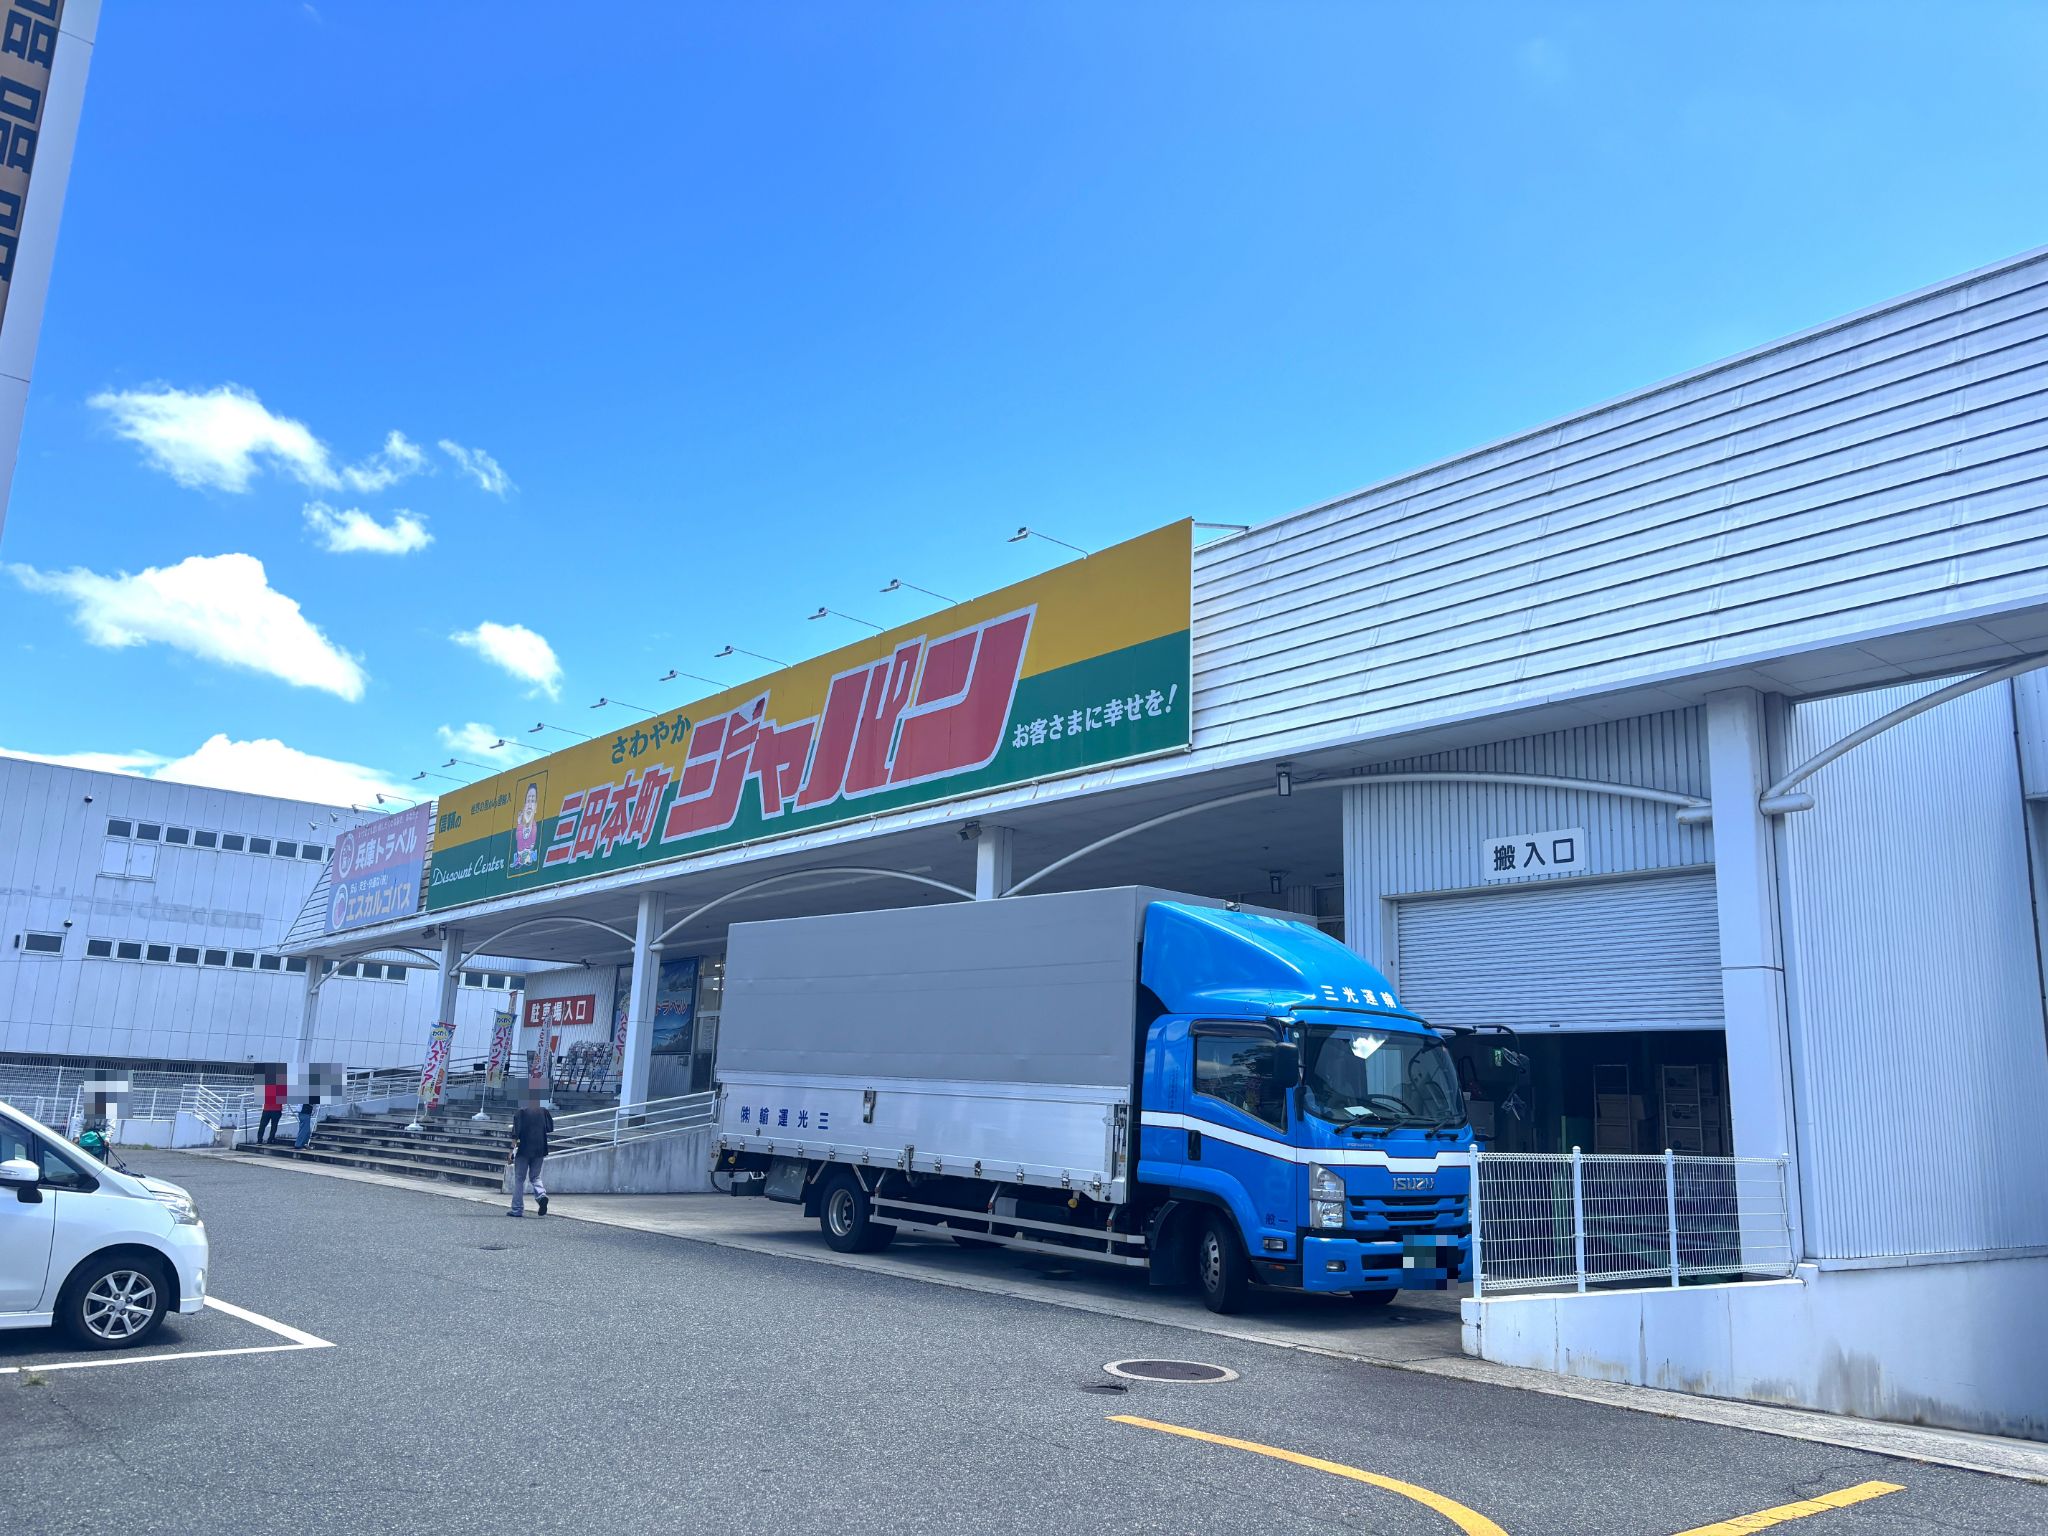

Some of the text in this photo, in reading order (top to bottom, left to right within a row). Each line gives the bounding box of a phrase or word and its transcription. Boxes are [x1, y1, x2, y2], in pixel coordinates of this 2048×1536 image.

[659, 603, 1038, 844] ジャパン
[1012, 683, 1178, 749] お客さまに幸せを!
[612, 714, 691, 764] さわやか
[543, 763, 674, 868] 三田本町
[355, 826, 417, 871] 兵庫トラベル
[1493, 838, 1575, 871] 搬入口
[431, 855, 505, 887] Discount Center
[346, 882, 411, 921] エスカルゴバス
[530, 1000, 587, 1023] 駐車場入口
[1393, 1177, 1434, 1190] ISUZU
